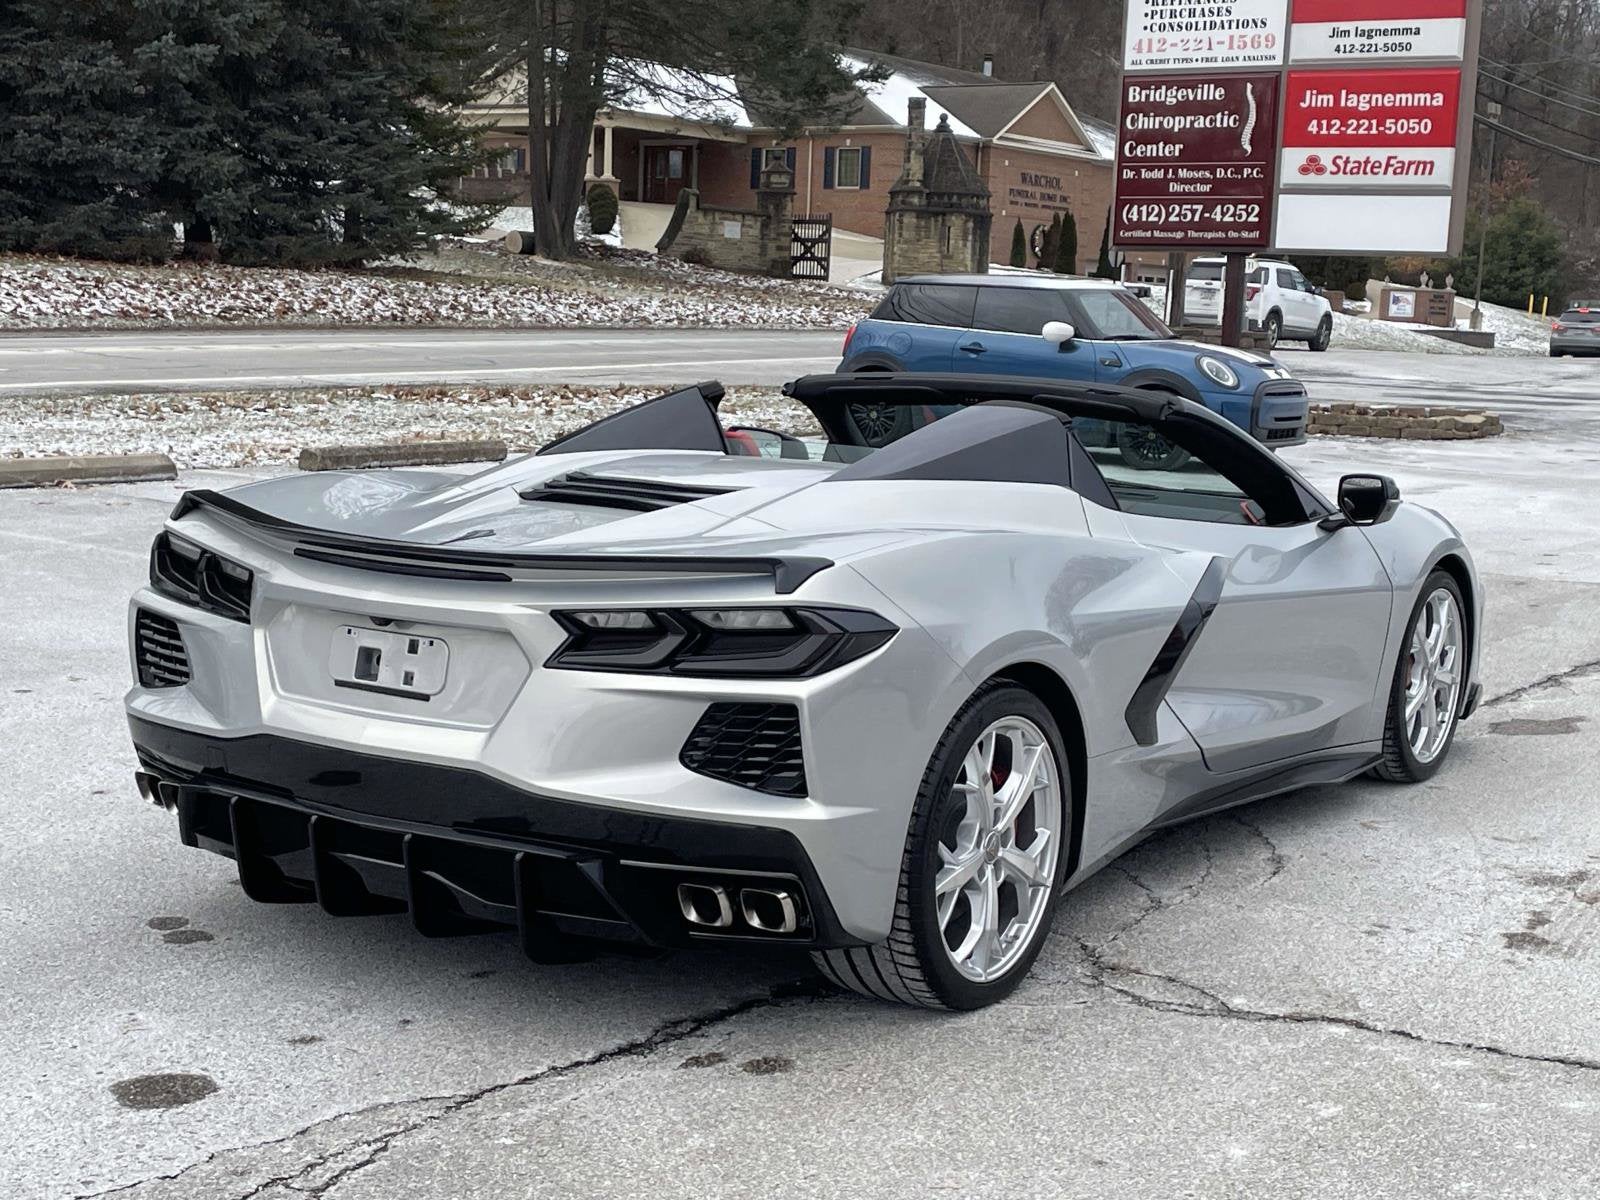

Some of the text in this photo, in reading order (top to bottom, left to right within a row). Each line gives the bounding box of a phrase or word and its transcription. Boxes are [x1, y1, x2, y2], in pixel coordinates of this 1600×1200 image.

[1150, 6, 1232, 19] PURCHASES
[1149, 18, 1268, 33] CONSOLIDATIONS
[1328, 26, 1421, 40] Jim Iagnemma
[1133, 33, 1276, 53] 412-221-1569
[1334, 41, 1412, 54] 412-221-5050
[1128, 84, 1225, 105] Bridgeville
[1300, 89, 1444, 111] Jim Iagnemma
[1126, 111, 1240, 132] Chiropractic
[1307, 118, 1432, 135] 412-221-5050
[1124, 140, 1183, 157] Center
[1122, 167, 1264, 180] Dr. Todd J. Moses, D.C., P.C.
[1169, 182, 1212, 193] Director
[1120, 230, 1260, 239] Certified Massage Therapists On-Staff
